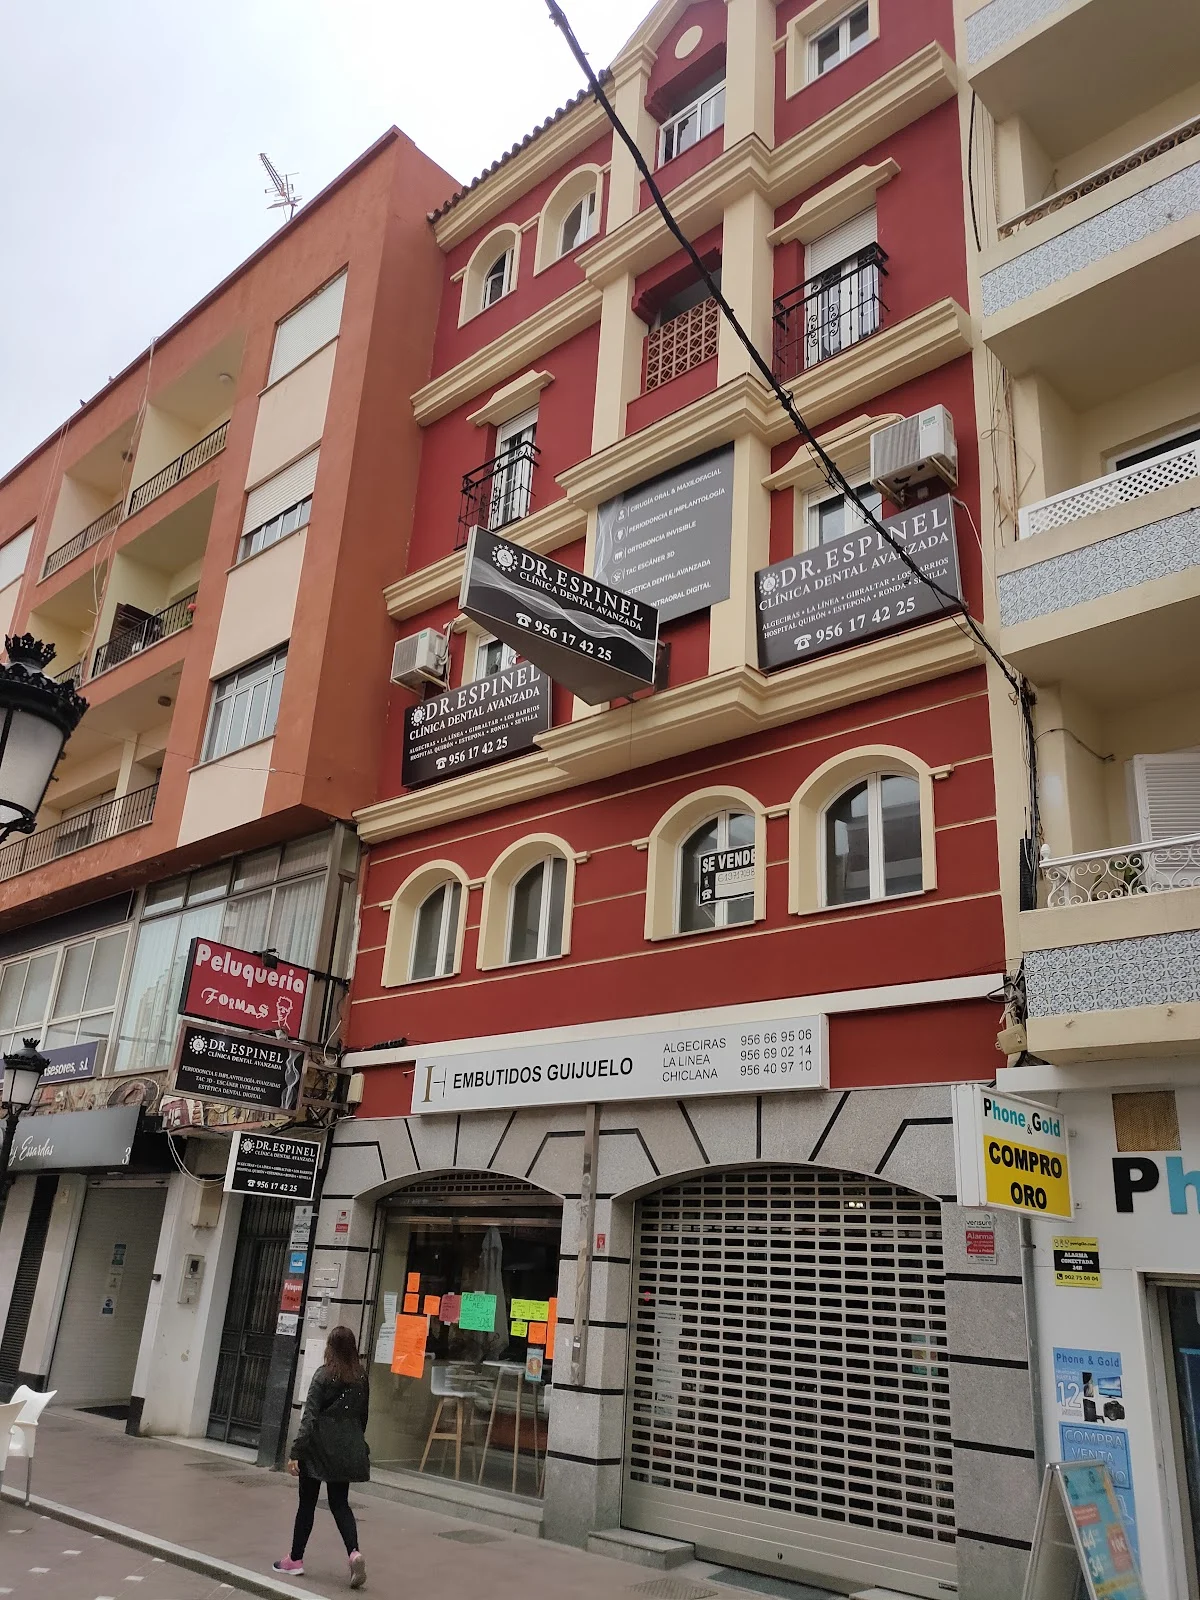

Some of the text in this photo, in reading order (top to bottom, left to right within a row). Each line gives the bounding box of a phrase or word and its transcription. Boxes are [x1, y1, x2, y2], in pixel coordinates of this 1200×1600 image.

[630, 497, 653, 512] CIRUGÍA
[654, 492, 670, 502] ORAL
[677, 468, 722, 493] MAXILOFACIAL
[629, 512, 668, 534] PERIODONCIA
[673, 487, 725, 514] IMPLANTOLOGÍA
[627, 520, 697, 554] ORTODONCIA INVISIBLE
[780, 507, 948, 588] DR. ESPINEL
[626, 551, 675, 576] TAC ESCÁNER 3D
[651, 571, 675, 587] DENTAL
[676, 558, 711, 578] AVANZADA
[519, 571, 642, 631] CLÍNICA DENTAL AVANZADA
[520, 552, 644, 622] DR. ESPINEL
[686, 581, 711, 595] DIGITAL
[759, 580, 811, 611] CLÍNICA
[814, 564, 868, 590] DENTAL
[762, 557, 949, 631] ALGECIRAS LA LÍNEA GIBRALTAR LOS ARRIOS
[764, 621, 798, 639] HOSPITAL
[798, 611, 826, 627] QUIRÓN
[833, 595, 871, 614] ESTEPONA
[878, 583, 906, 599] RONDA
[816, 597, 916, 645] 956 17 42 25
[535, 620, 612, 661] 956 17 42 25
[426, 664, 541, 721] DR. ESPINEL
[410, 686, 540, 740] CLÍNICA DENTAL AVANZADA
[409, 741, 435, 754] ALGECIRAS
[448, 730, 463, 740] LÍNEA
[469, 718, 499, 733] GIBRALTAR
[504, 713, 514, 721] LOS
[516, 705, 540, 718] BARRIOS
[410, 749, 433, 761] HOSPITAL
[459, 731, 485, 744] ESTEPONA
[491, 723, 509, 733] RONDA
[515, 713, 538, 725] SEVILLA
[449, 736, 508, 765] 956 17 42 25
[702, 856, 715, 873] SE
[195, 943, 305, 994] Peluqueria
[209, 1039, 283, 1063] DR. ESPINEL
[663, 1029, 812, 1053] ALGECIRAS 956 66 95 06
[182, 1065, 214, 1076] PERIODONCIA
[208, 1051, 281, 1070] CLÍNICA DENTAL AVANZADA
[663, 1044, 812, 1068] LA LINEA 956 69 02 14
[453, 1065, 542, 1089] EMBUTIDOS
[547, 1057, 633, 1081] GUIJUELO
[662, 1060, 812, 1082] CHICLANA 956 40 97 10
[198, 1084, 222, 1093] ESTÉTICA
[222, 1088, 242, 1096] DENTAL
[217, 1079, 238, 1088] ESCÁNER
[240, 1084, 266, 1093] INTRAORAL
[983, 1097, 1061, 1137] Phone & Gold
[122, 1147, 131, 1165] 3
[256, 1140, 315, 1157] DR. ESPINEL
[988, 1141, 1062, 1179] COMPRO
[256, 1180, 269, 1188] 956
[1010, 1181, 1047, 1209] ORO
[1056, 1353, 1119, 1367] Phone & Gold
[1057, 1381, 1081, 1408] 12
[1065, 1429, 1124, 1450] COMPRA
[1071, 1447, 1116, 1464] VENTA
